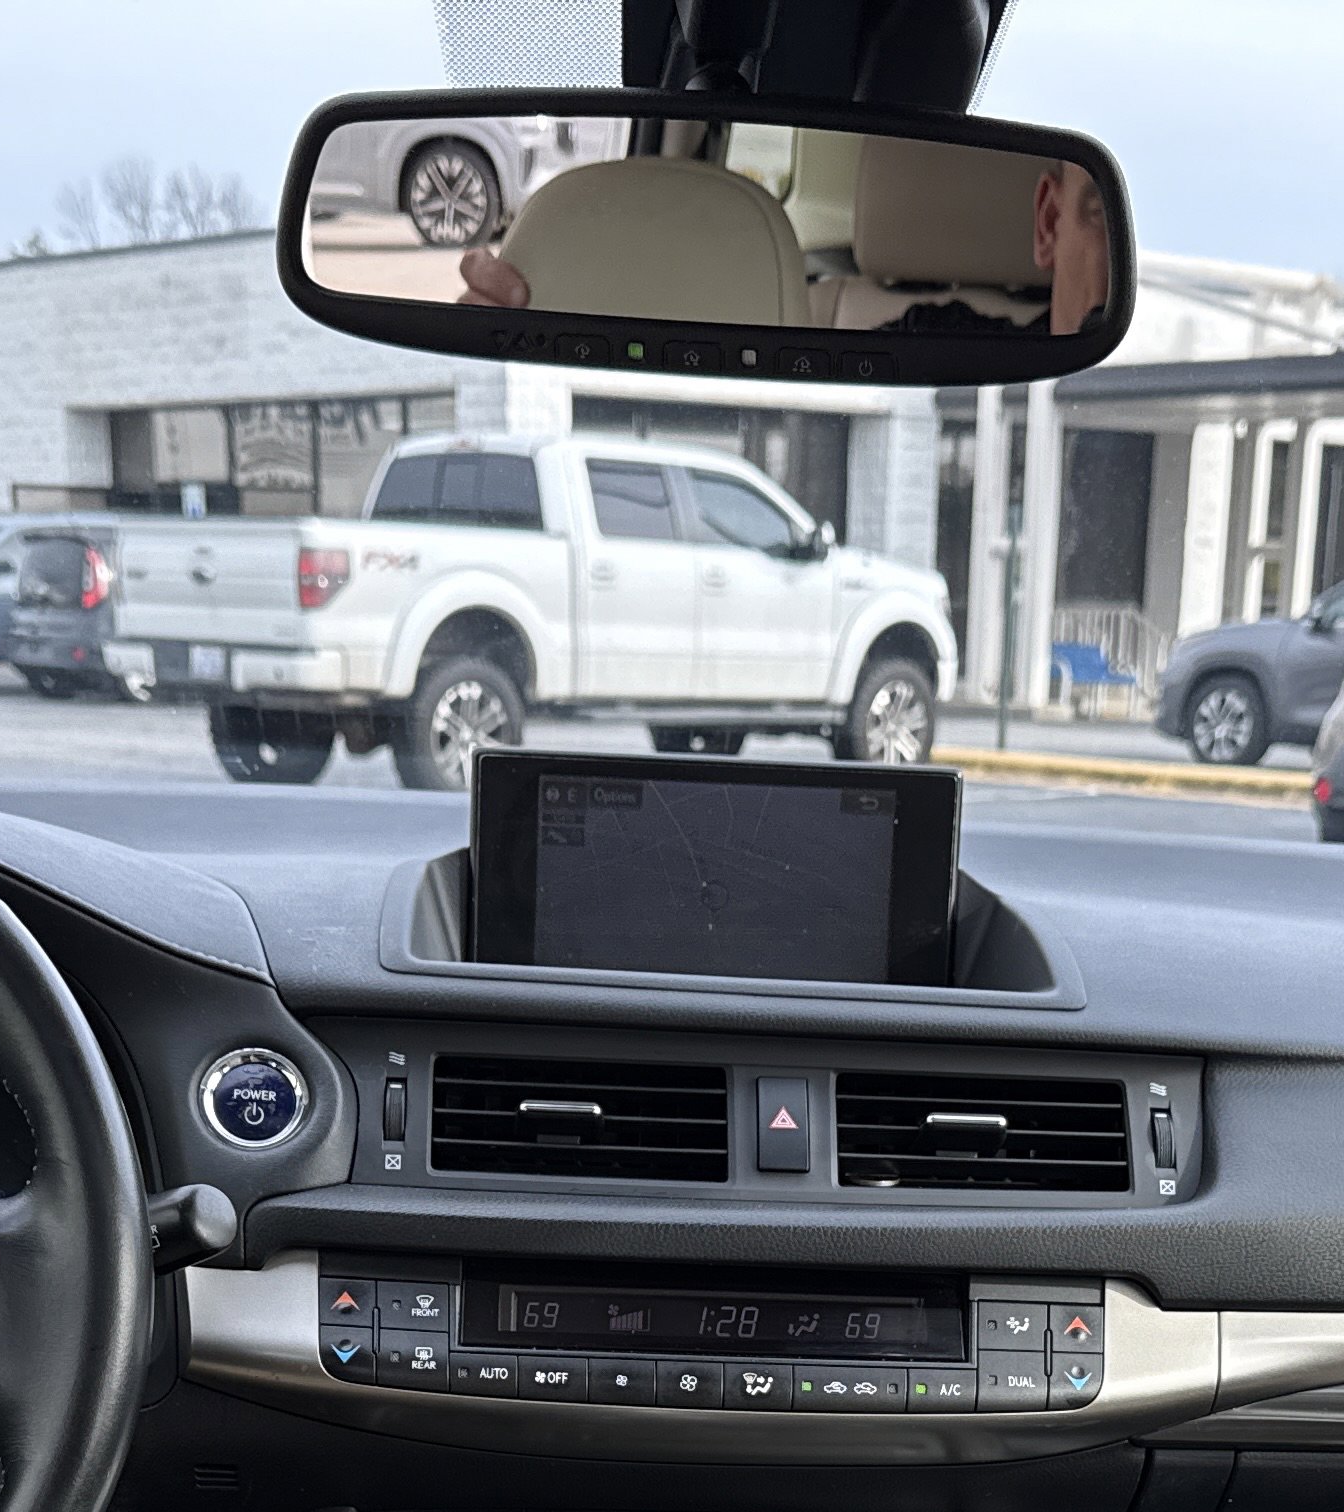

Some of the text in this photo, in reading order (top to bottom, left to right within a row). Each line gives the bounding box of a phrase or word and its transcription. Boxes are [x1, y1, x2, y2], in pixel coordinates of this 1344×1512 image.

[233, 1088, 277, 1101] POWER
[411, 1308, 440, 1317] FRONT
[523, 1302, 560, 1328] 69
[698, 1305, 760, 1339] 1:28
[844, 1312, 881, 1339] 69
[411, 1360, 437, 1370] REAR
[479, 1368, 509, 1380] AUTO
[546, 1372, 569, 1384] OFF
[1008, 1375, 1036, 1388] DUAL
[940, 1383, 962, 1397] A/C
